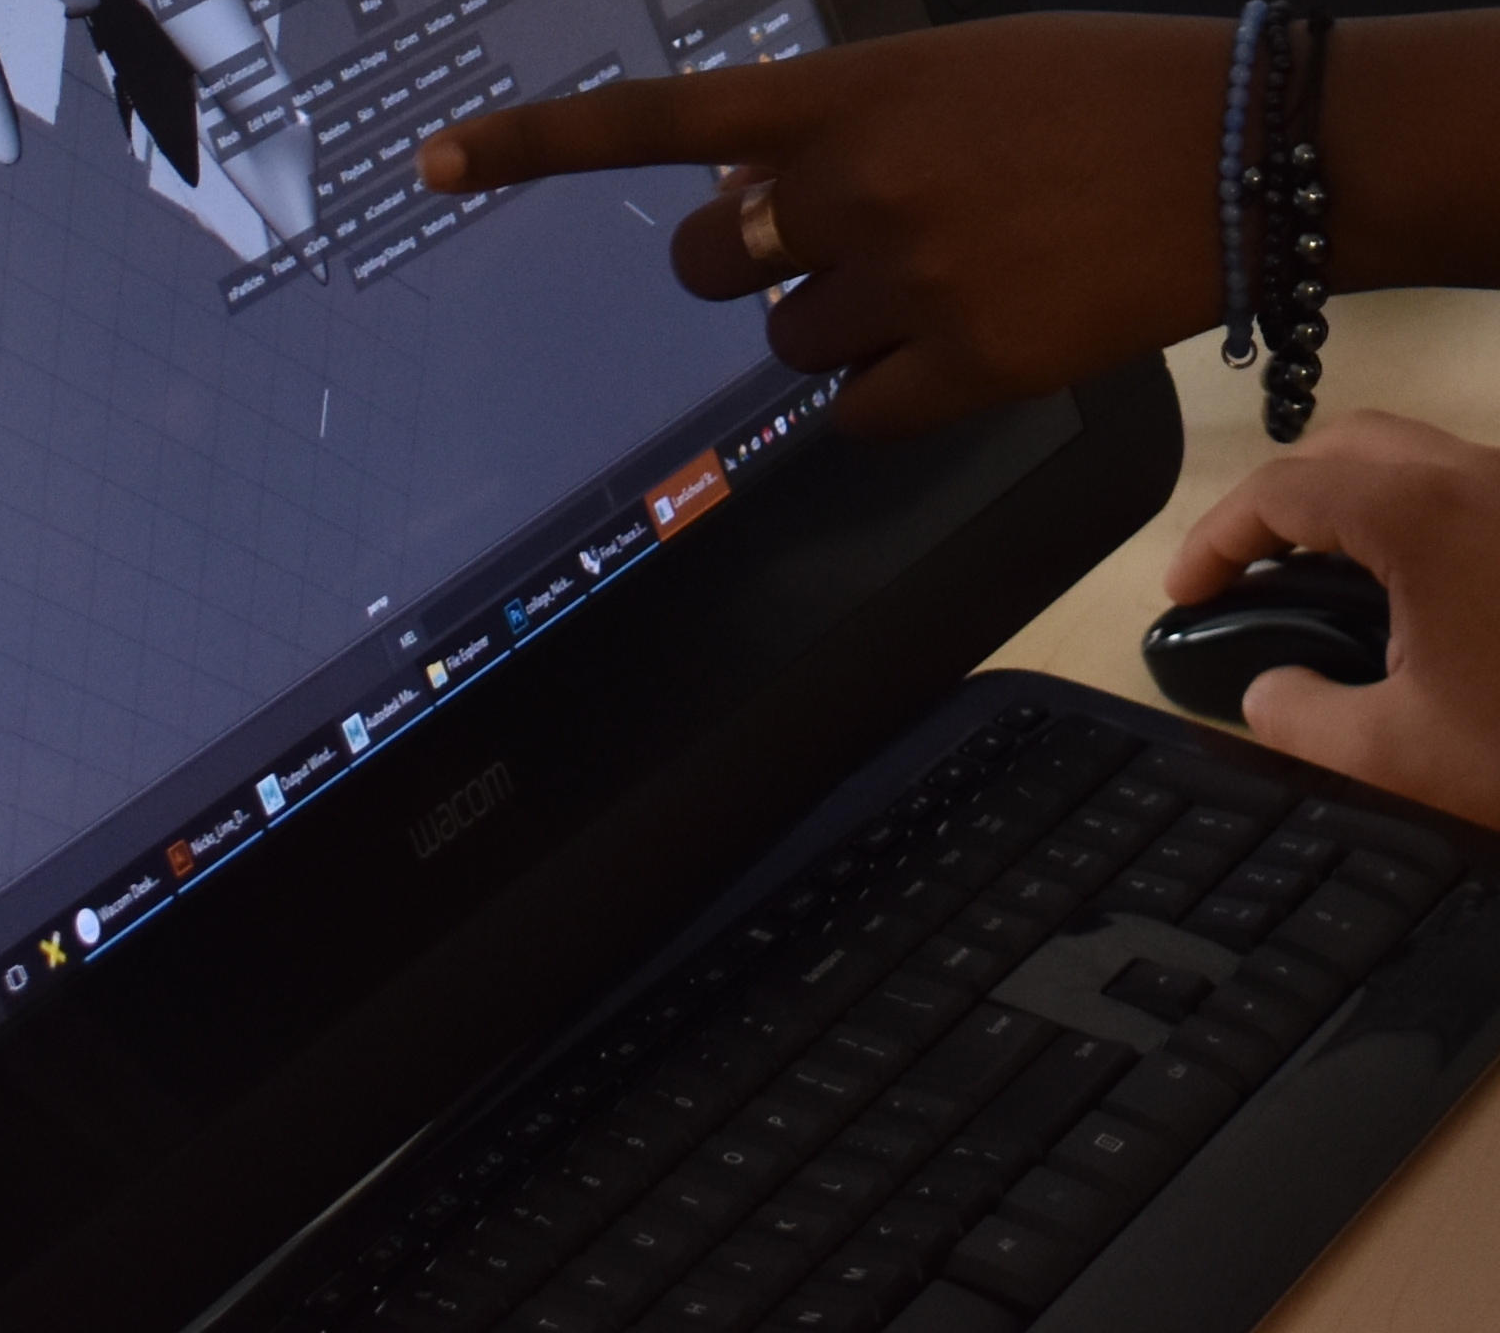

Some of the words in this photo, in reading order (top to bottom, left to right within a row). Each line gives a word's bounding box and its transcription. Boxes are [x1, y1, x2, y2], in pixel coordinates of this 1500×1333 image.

[393, 30, 420, 52] Curves
[225, 54, 268, 85] Commands
[339, 62, 361, 82] Mesh
[359, 47, 389, 73] Display
[291, 87, 315, 108] Mesh
[312, 77, 334, 97] Tools
[317, 117, 351, 145] Skeleton
[356, 104, 376, 123] Skin
[381, 85, 410, 109] Deform
[414, 63, 450, 91] Constrain
[454, 45, 483, 69] Control
[216, 127, 241, 149] Mesh
[246, 114, 264, 133] Edit
[262, 103, 286, 124] Mesh
[316, 178, 335, 199] Key
[339, 155, 375, 186] Playback
[378, 134, 412, 162] Visualize
[449, 92, 485, 121] Constrain
[271, 253, 297, 277] Fluids
[352, 233, 418, 282] Lighting/Shading
[365, 593, 390, 618] persp
[398, 627, 418, 650] MEL
[444, 652, 460, 673] File
[456, 631, 492, 668] Explorer
[363, 698, 397, 732] Autodesk
[279, 760, 313, 797] Output
[308, 742, 338, 773] Wind...
[406, 760, 514, 860] wacom
[96, 888, 132, 924] Wacom
